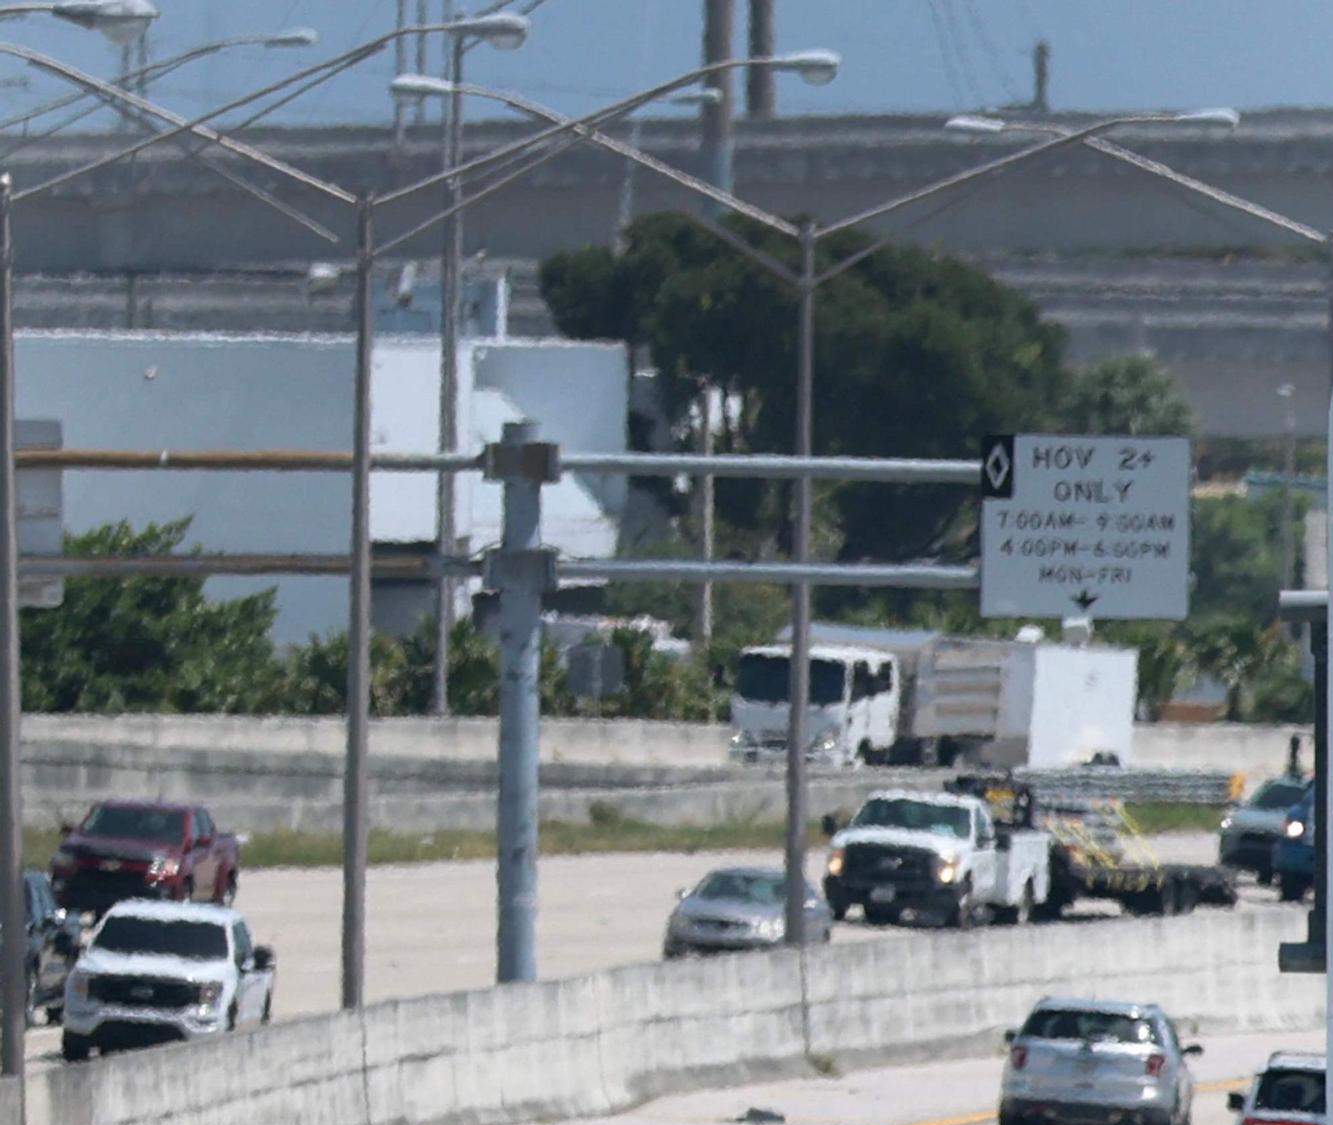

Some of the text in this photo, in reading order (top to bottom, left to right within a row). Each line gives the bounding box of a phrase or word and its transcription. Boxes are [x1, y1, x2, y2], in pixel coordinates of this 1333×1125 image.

[1032, 445, 1155, 471] HOV 2+
[1054, 480, 1133, 503] ONLY
[1038, 566, 1133, 584] MON-FRI
